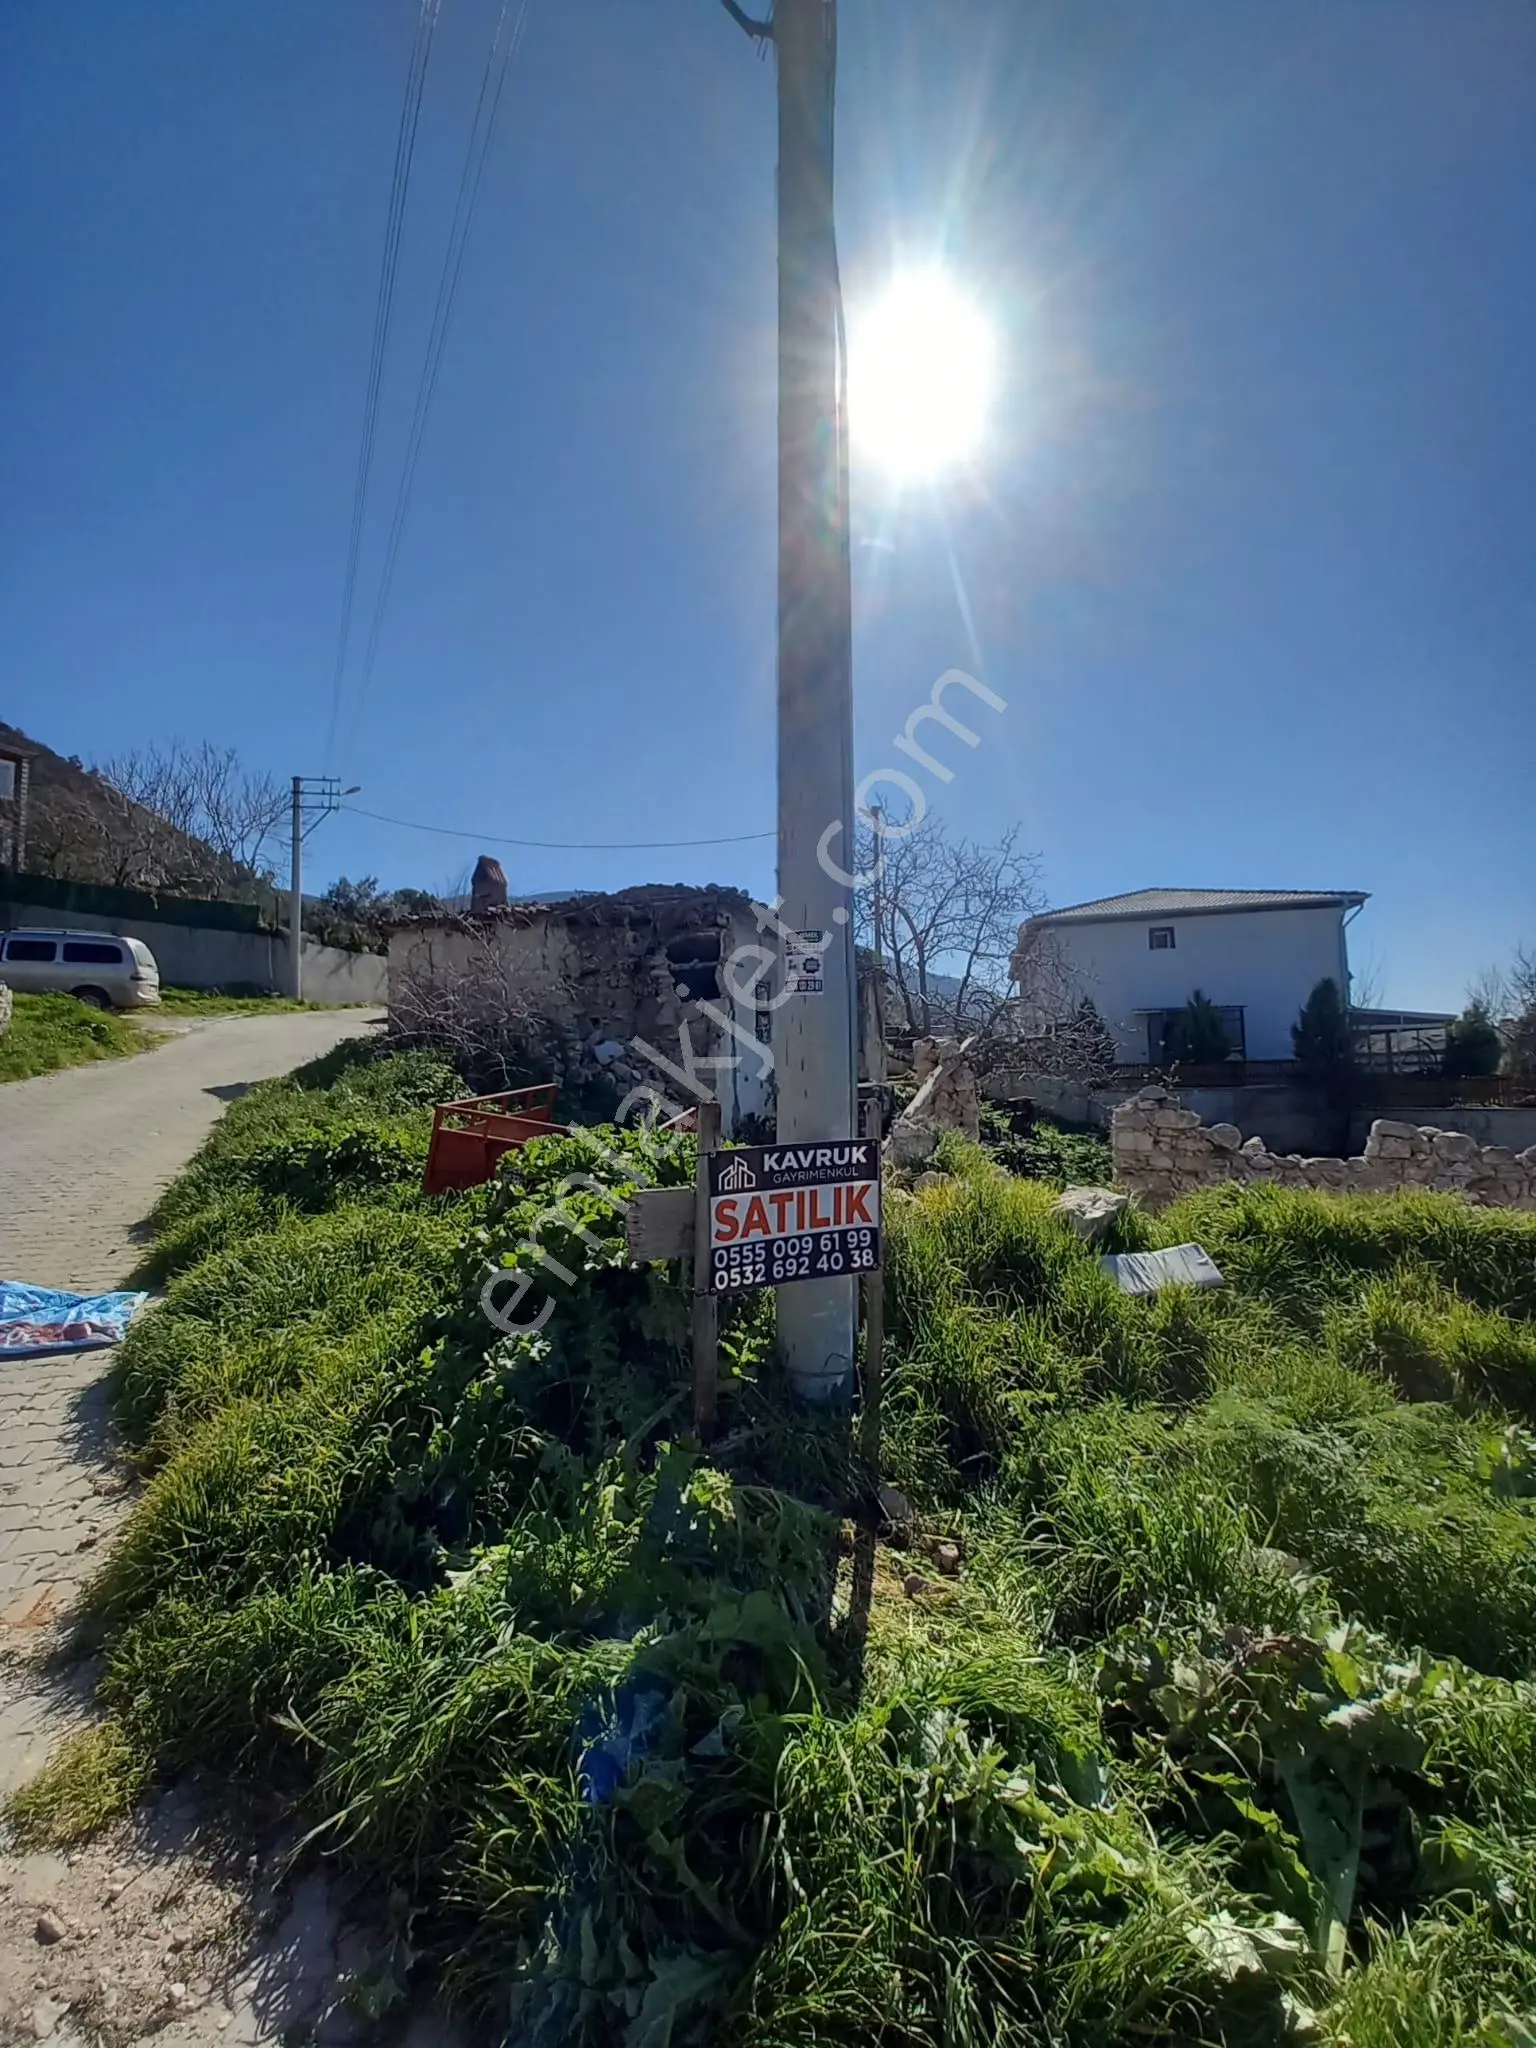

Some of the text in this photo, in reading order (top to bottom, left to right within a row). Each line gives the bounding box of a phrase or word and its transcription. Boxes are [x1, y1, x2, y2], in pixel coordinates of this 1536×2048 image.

[763, 1145, 868, 1172] KAVRUK
[714, 1184, 873, 1242] SATILIK
[714, 1229, 871, 1268] 0555 009 61 99
[714, 1249, 874, 1290] 0532 692 40 38
